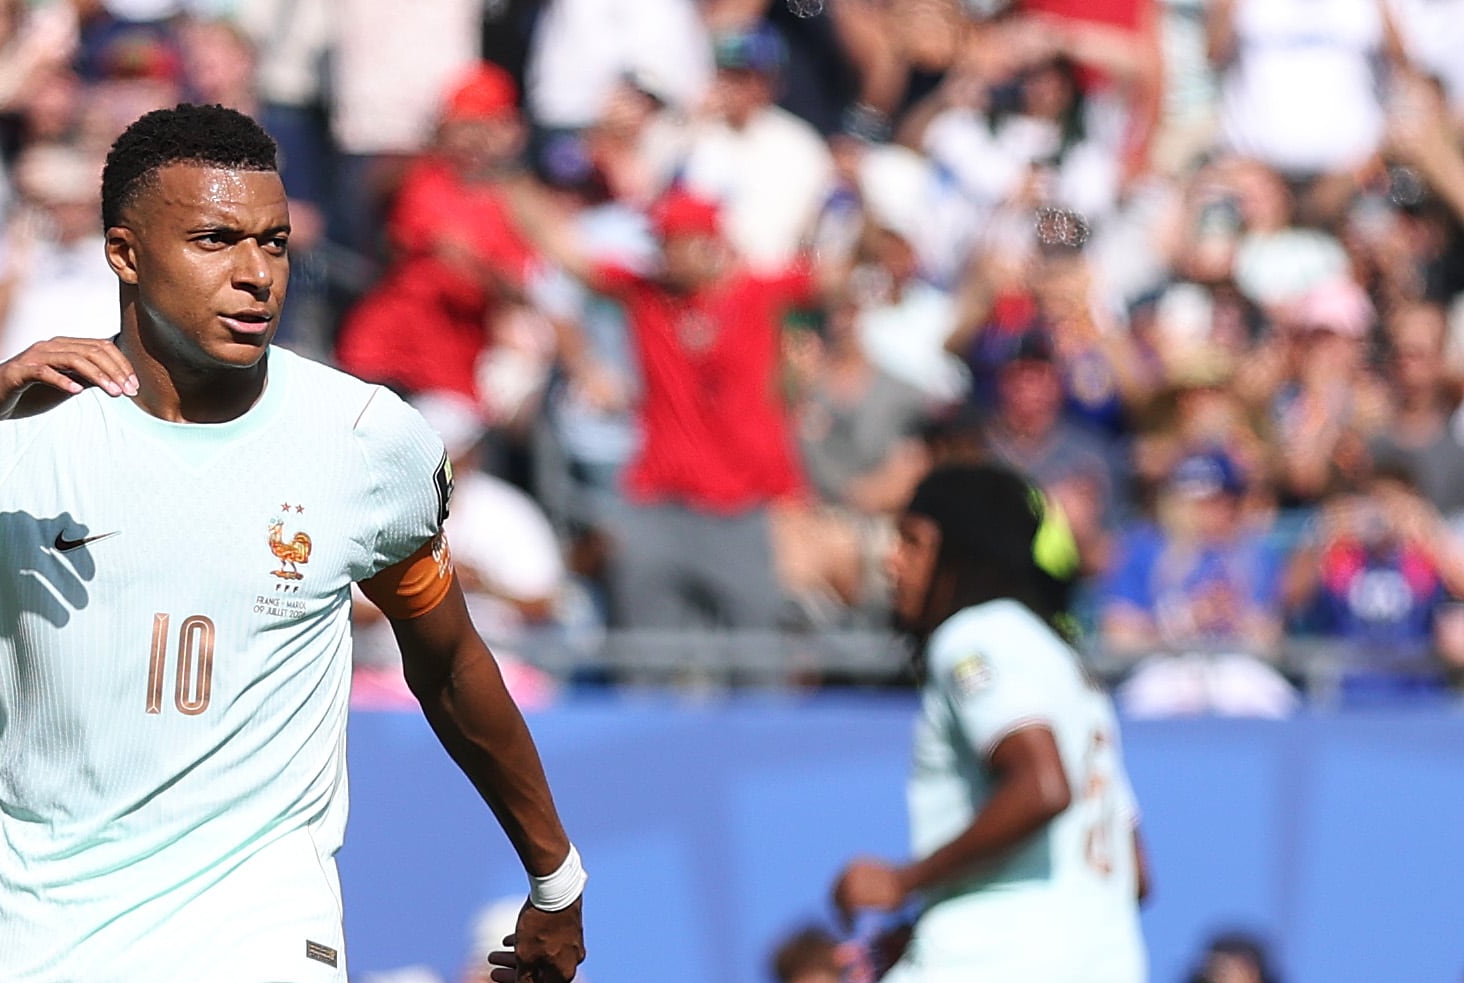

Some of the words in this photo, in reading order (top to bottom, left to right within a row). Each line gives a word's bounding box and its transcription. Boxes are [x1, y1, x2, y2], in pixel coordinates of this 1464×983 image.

[256, 595, 280, 606] FRANCE
[253, 604, 265, 614] 09
[145, 612, 216, 716] 10
